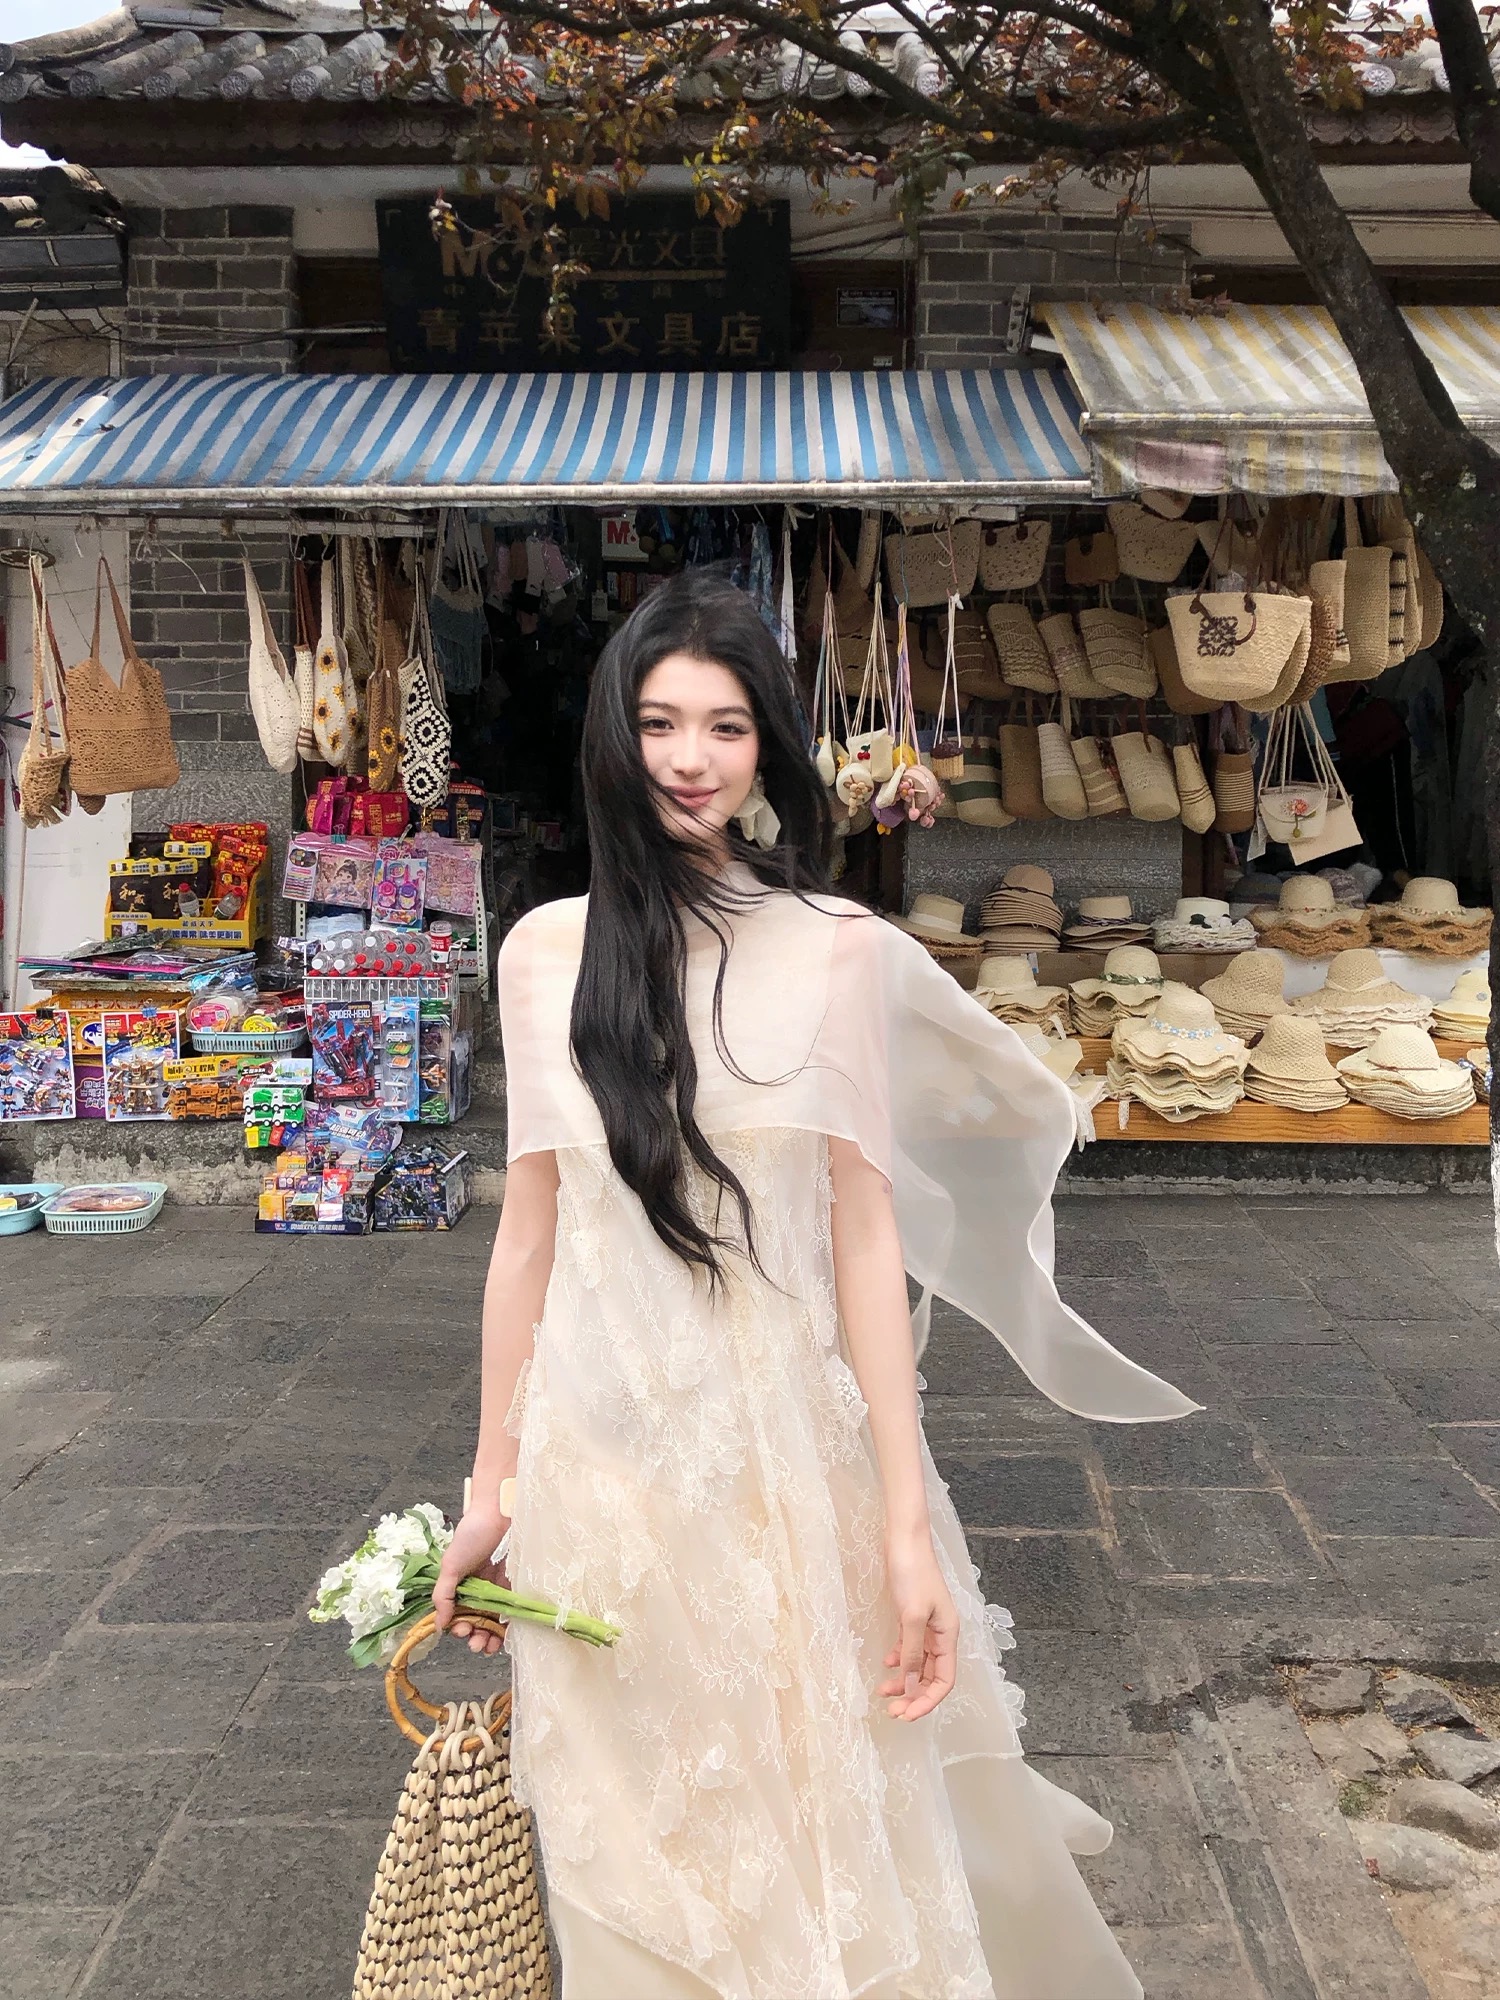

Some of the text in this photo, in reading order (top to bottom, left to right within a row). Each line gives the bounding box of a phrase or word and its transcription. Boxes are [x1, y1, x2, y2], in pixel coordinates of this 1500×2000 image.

[417, 308, 762, 357] 青苹果文具店
[329, 1009, 371, 1020] SPIDER-HERO
